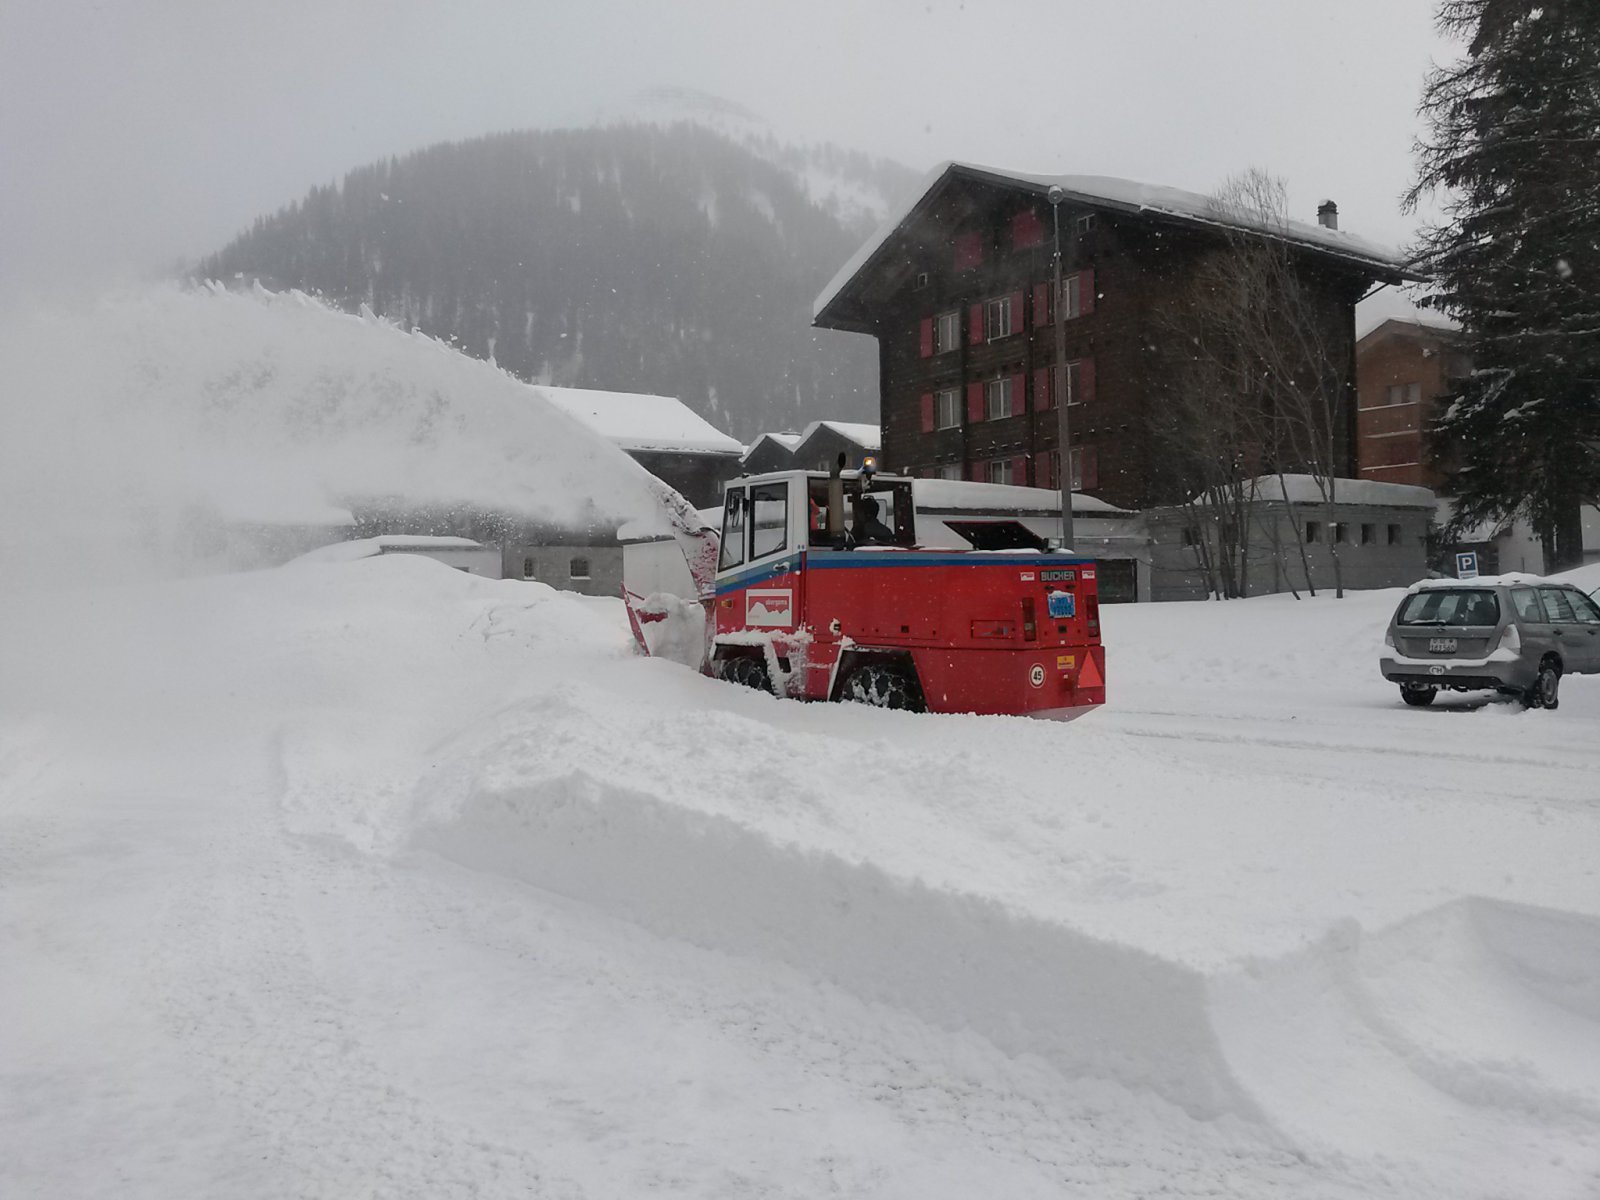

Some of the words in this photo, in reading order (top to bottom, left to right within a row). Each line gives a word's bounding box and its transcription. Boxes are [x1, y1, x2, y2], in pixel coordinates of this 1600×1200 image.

[1461, 557, 1473, 570] P
[1040, 570, 1075, 581] BUCHER
[1033, 670, 1042, 681] 45
